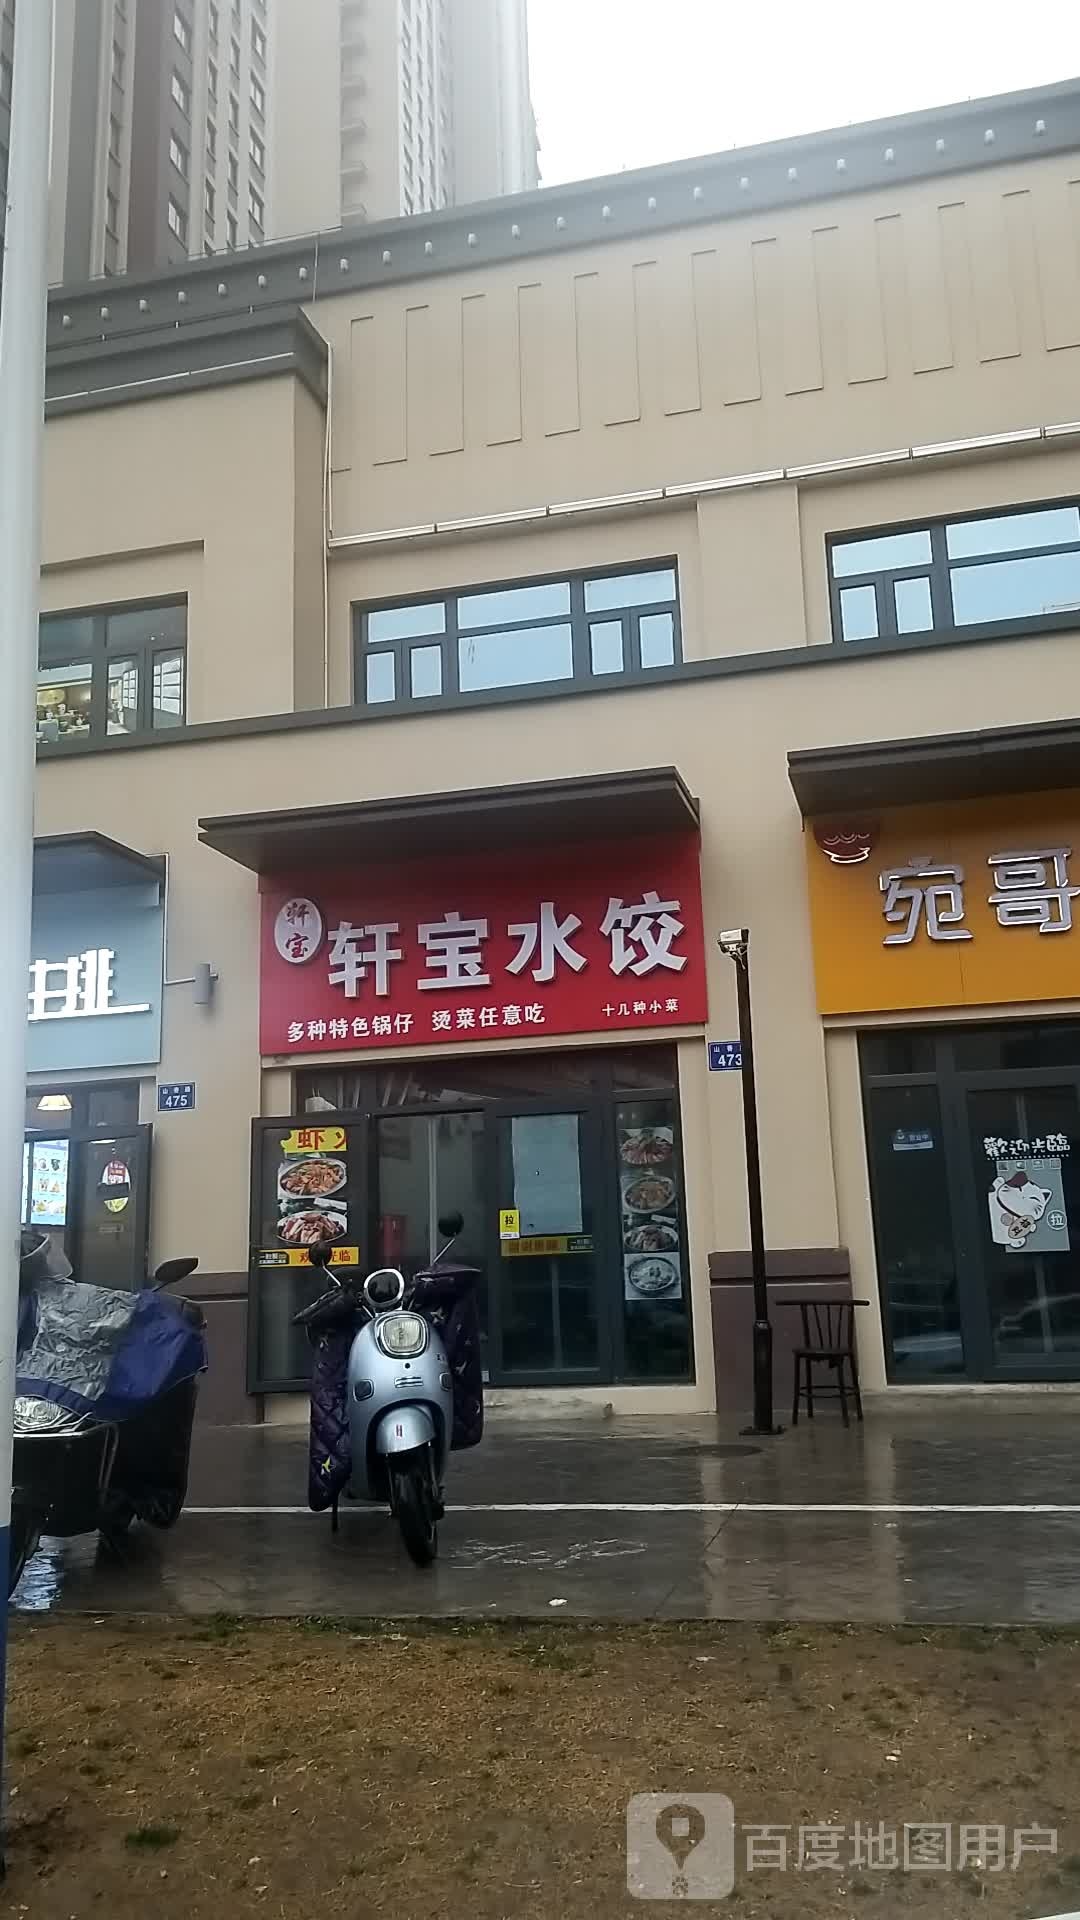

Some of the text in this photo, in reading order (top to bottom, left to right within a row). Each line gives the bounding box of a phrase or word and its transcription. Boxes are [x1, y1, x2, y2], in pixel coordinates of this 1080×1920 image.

[327, 891, 689, 998] 轩宝水饺
[601, 998, 679, 1017] 十几种小菜
[431, 1003, 546, 1032] 烫菜任意吃
[287, 1013, 414, 1043] 多种特色锅仔
[717, 1053, 742, 1066] 473
[165, 1094, 188, 1107] 475
[504, 1215, 514, 1225] 拉
[1050, 1213, 1064, 1226] 拉
